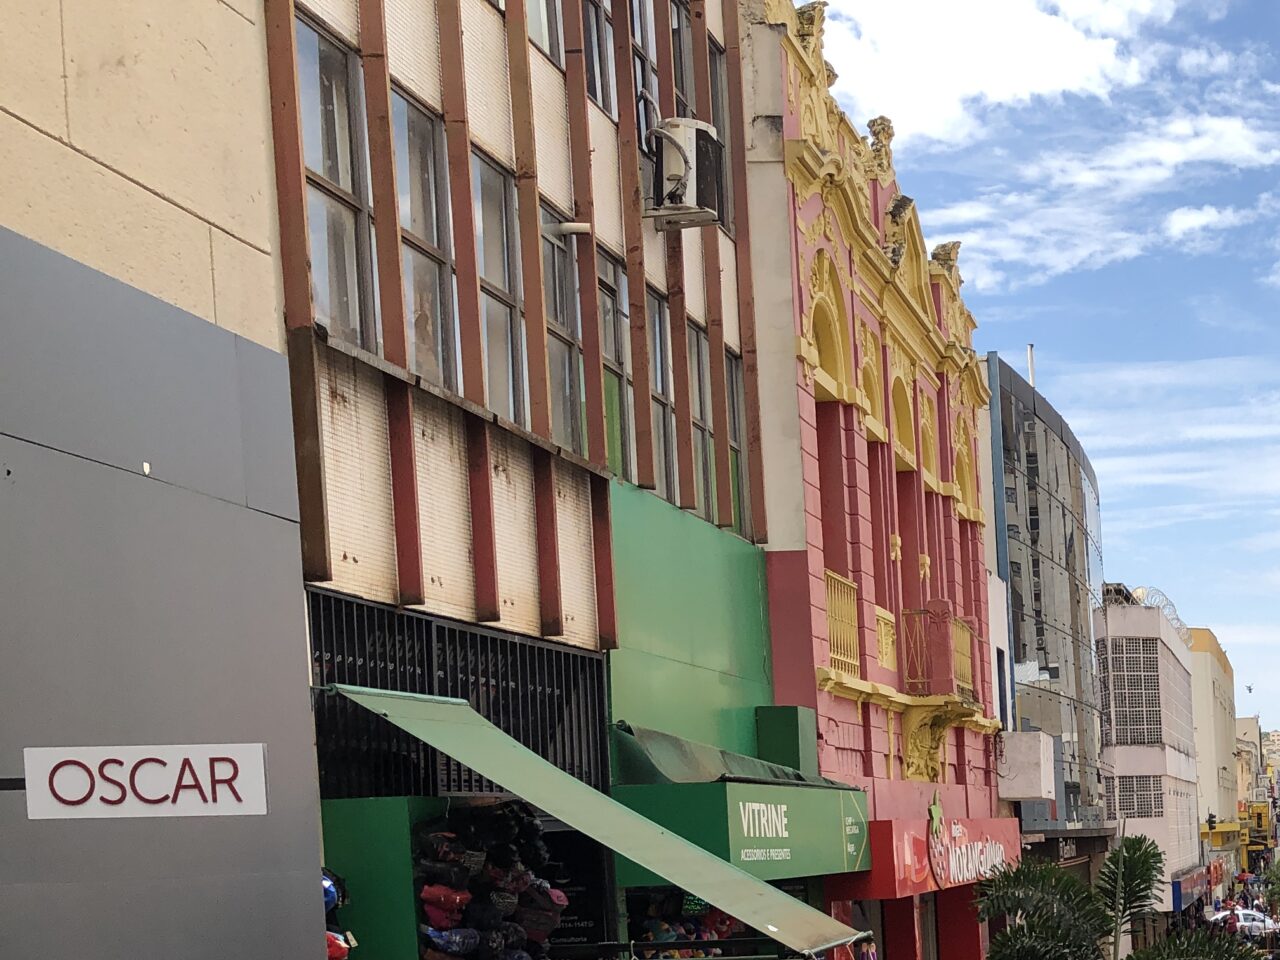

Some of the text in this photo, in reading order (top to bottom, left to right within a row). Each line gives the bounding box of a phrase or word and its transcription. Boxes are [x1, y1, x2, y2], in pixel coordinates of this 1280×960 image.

[48, 757, 243, 806] OSCAR
[739, 802, 789, 838] VITRINE
[740, 845, 767, 861] ACESSÓRIOS
[770, 848, 792, 861] PRESENTES
